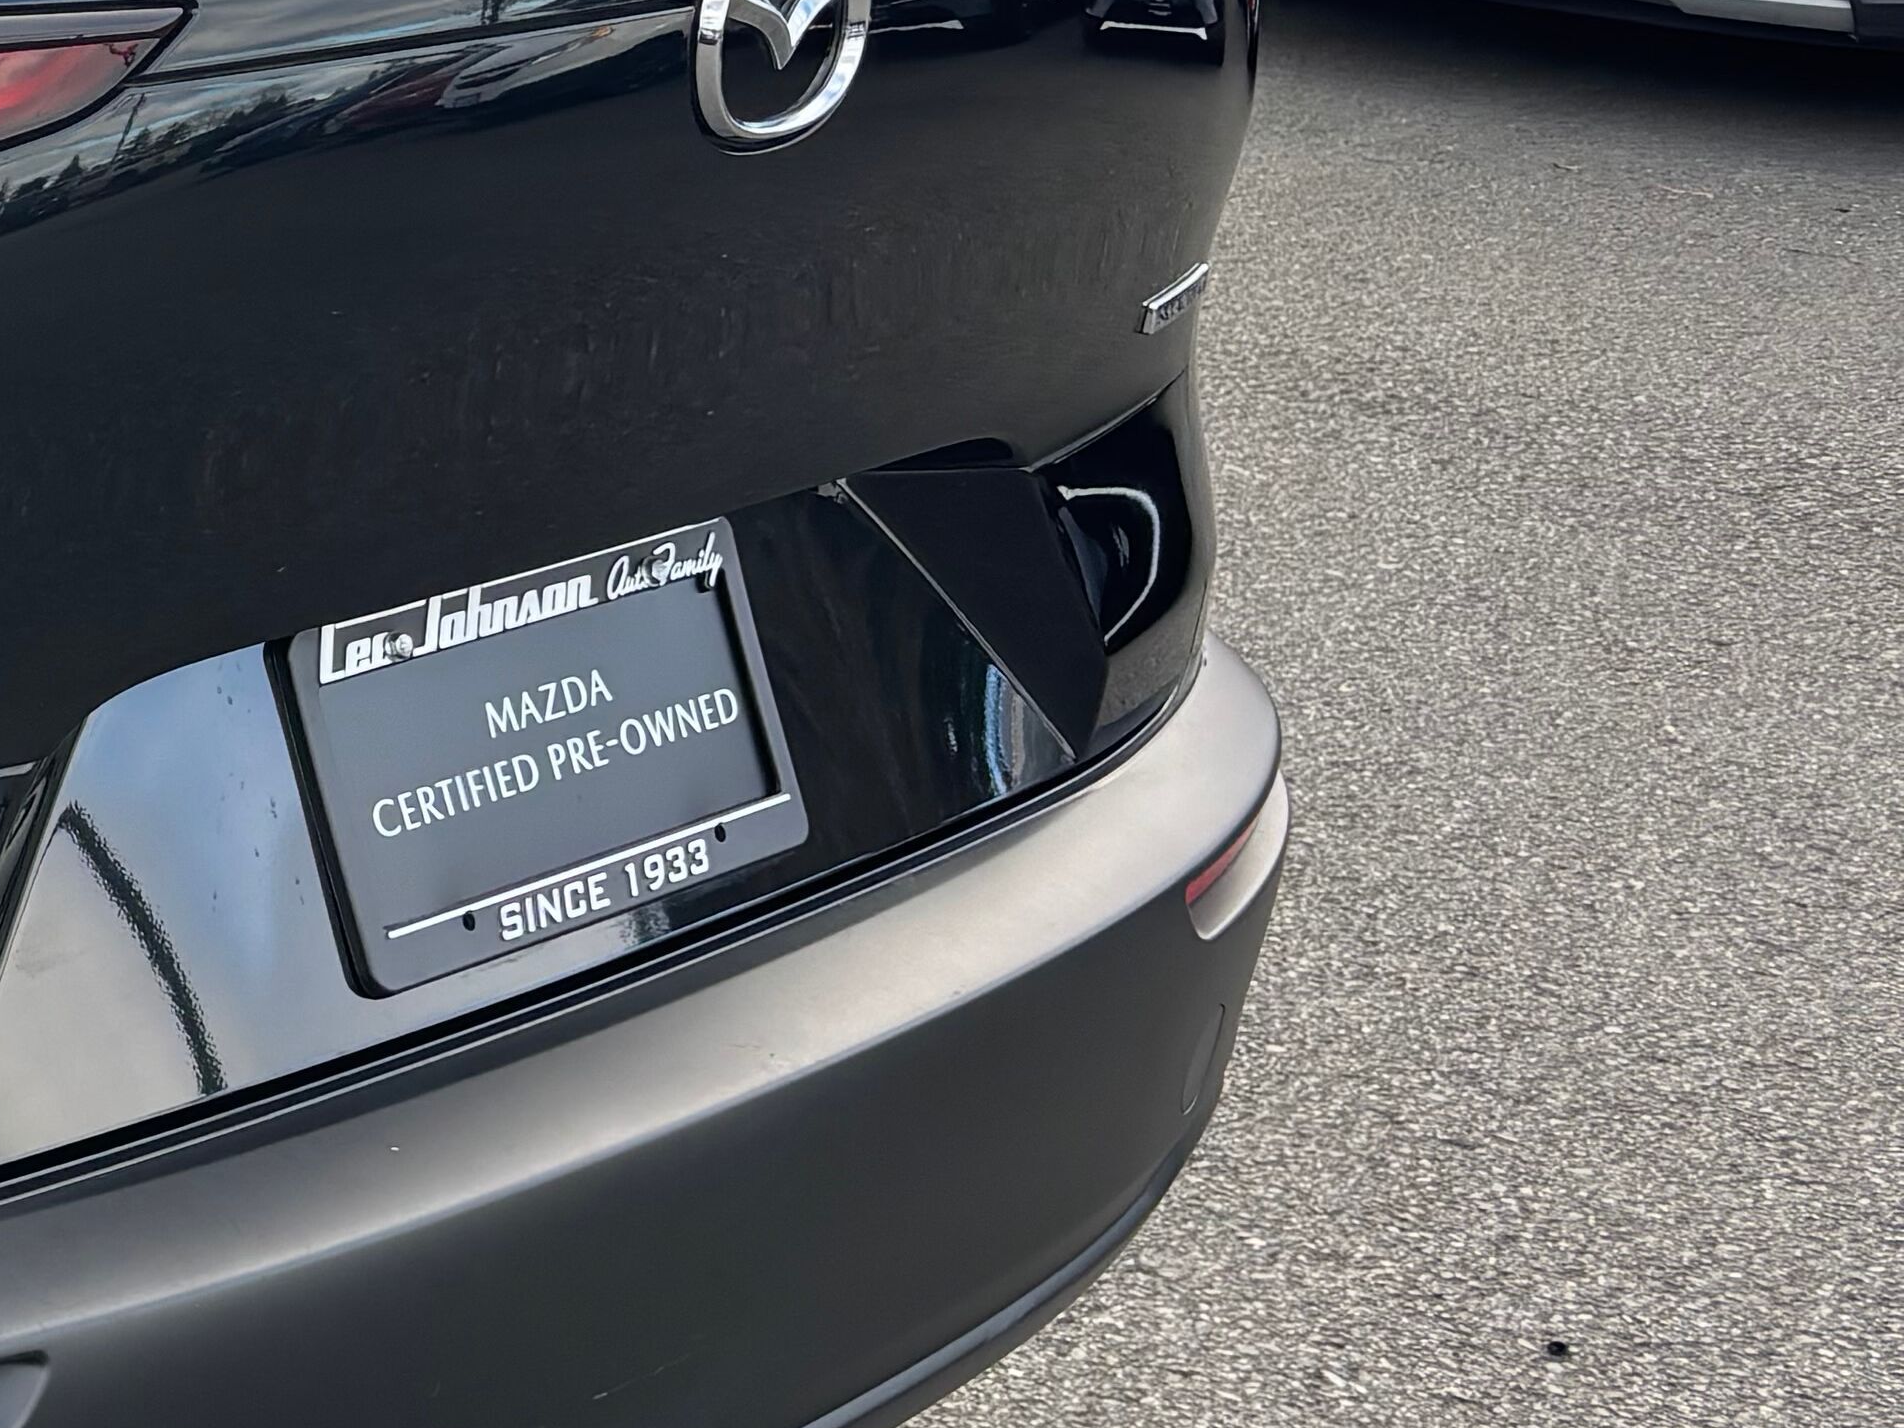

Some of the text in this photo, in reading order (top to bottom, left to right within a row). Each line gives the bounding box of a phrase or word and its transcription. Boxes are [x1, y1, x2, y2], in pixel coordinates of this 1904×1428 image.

[412, 573, 599, 658] Johnson
[653, 531, 724, 588] Family
[484, 668, 614, 739] MAZDA
[371, 687, 740, 838] CERTIFIED PRE-OWNED
[499, 837, 710, 942] SINCE 1933
